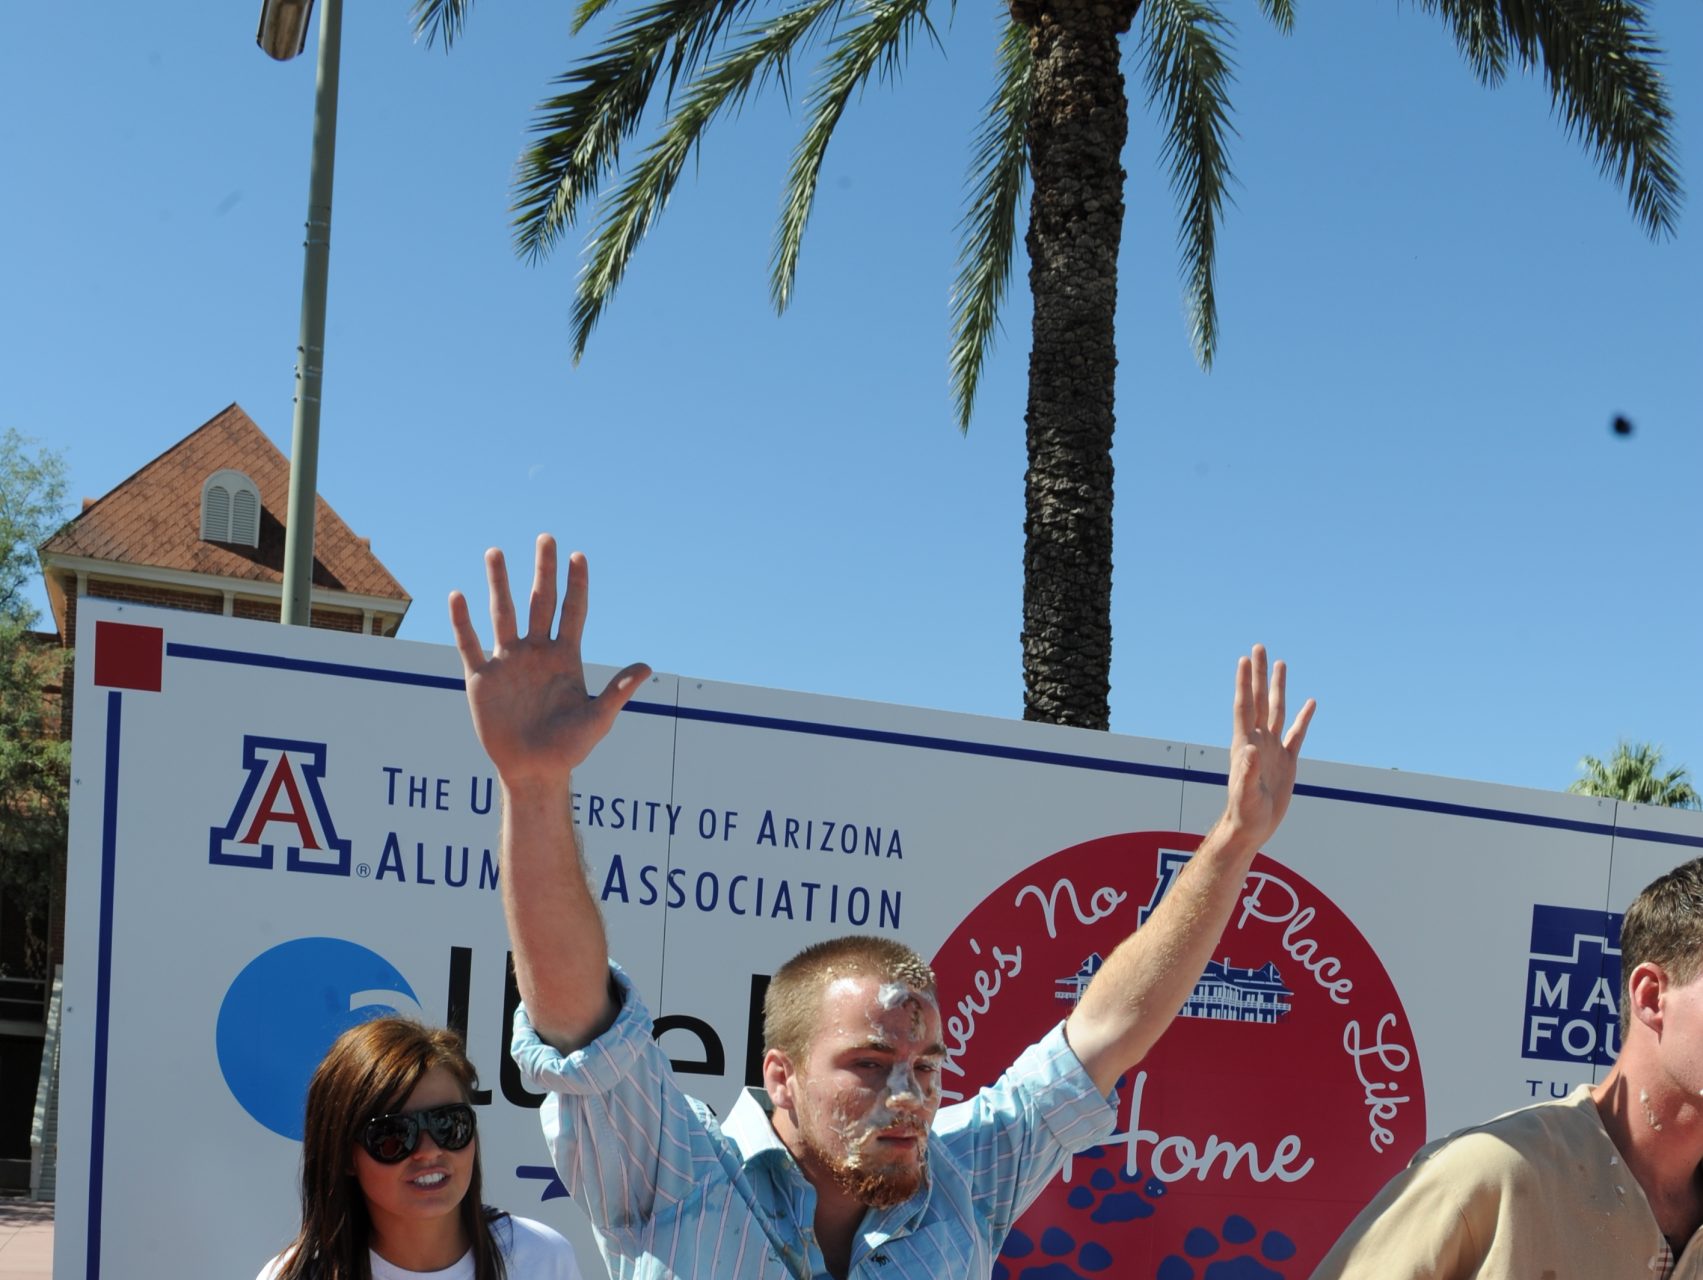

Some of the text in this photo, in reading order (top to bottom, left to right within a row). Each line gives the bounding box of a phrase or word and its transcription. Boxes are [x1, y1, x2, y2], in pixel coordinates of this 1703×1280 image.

[383, 767, 450, 811] THE
[698, 808, 738, 841] OF
[756, 809, 903, 860] ARIZONA
[601, 854, 902, 930] ASSOCIATION
[1014, 878, 1128, 939] No
[1237, 871, 1353, 1005] Place
[1062, 1070, 1315, 1184] Home
[1342, 1012, 1410, 1154] Like
